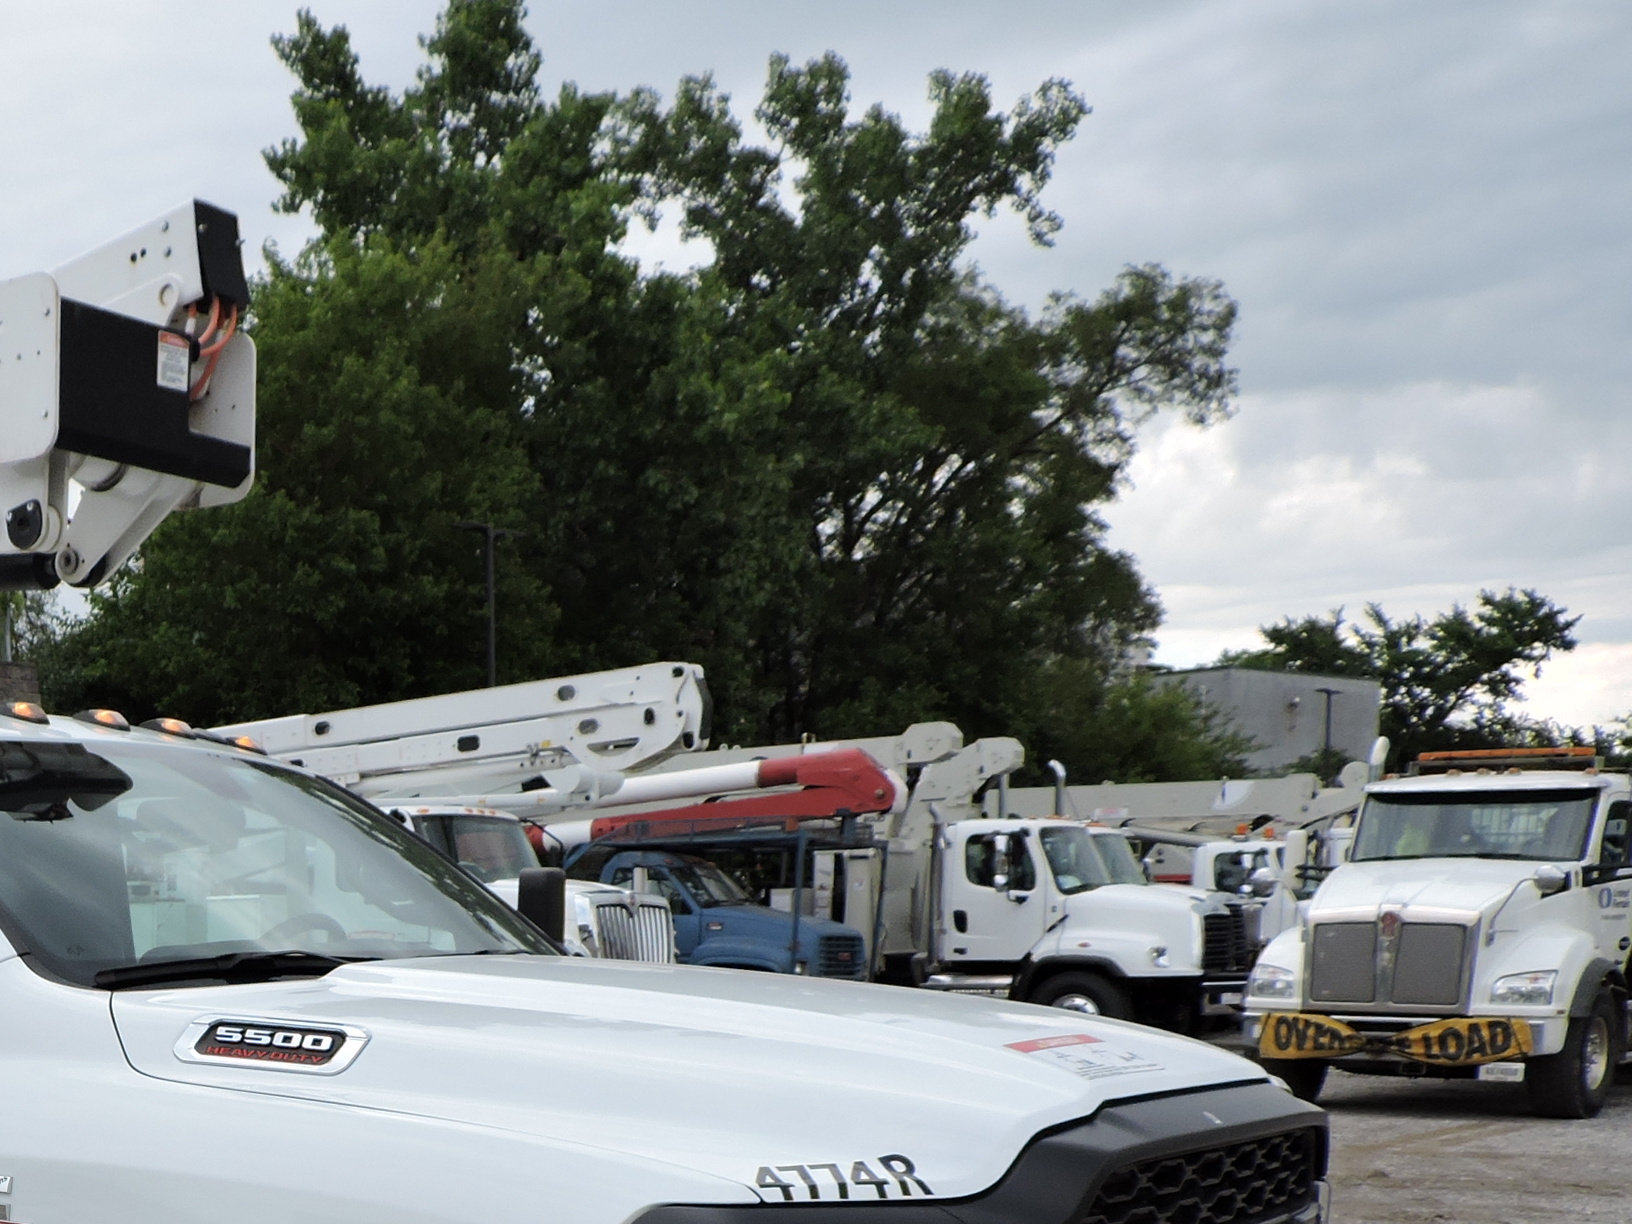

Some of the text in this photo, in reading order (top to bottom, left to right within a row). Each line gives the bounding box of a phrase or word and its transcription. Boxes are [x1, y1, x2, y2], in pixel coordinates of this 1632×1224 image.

[206, 1046, 327, 1063] HEAVY DUTY
[215, 1026, 333, 1051] 5500
[1422, 1020, 1511, 1061] LOAD
[755, 1154, 935, 1201] 4774R
